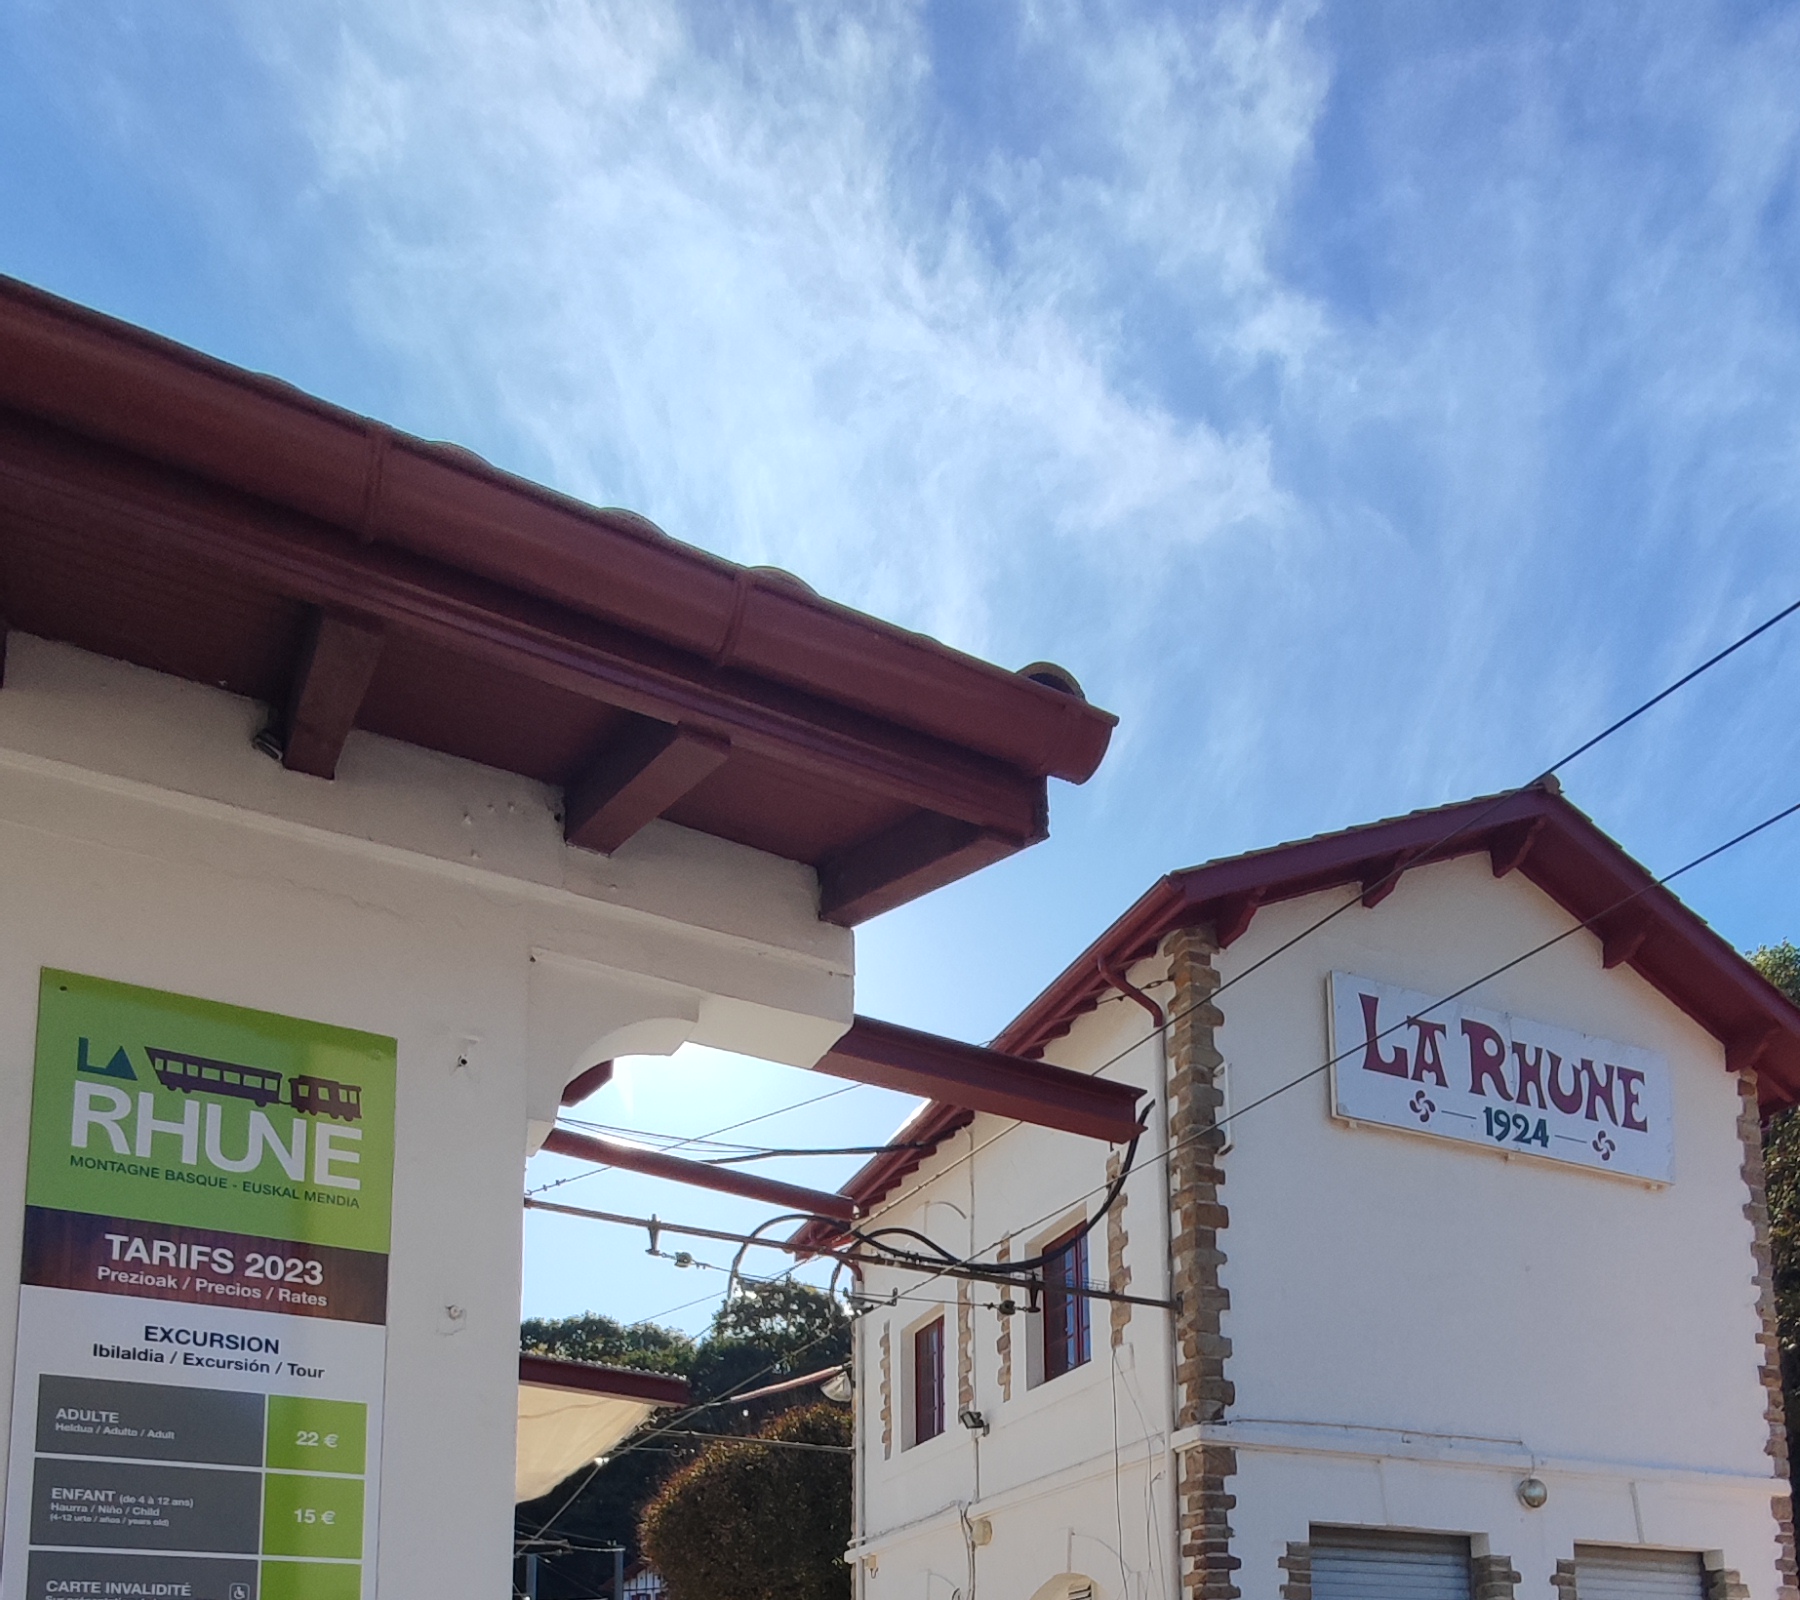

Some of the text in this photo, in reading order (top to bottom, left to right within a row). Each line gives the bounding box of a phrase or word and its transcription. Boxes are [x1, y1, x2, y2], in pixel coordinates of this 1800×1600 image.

[77, 1037, 138, 1081] LA
[1358, 992, 1648, 1133] LA RHUNE
[70, 1079, 363, 1191] RHUNE
[1482, 1106, 1550, 1148] 1924
[70, 1154, 160, 1179] MONTAGNE
[165, 1169, 228, 1189] BASQUE
[242, 1181, 300, 1200] EUSKAL
[304, 1190, 360, 1209] MENDIA
[104, 1233, 324, 1286] TARIFS 2023
[97, 1265, 178, 1290] Prezioak
[195, 1278, 262, 1299] Precios
[278, 1288, 328, 1307] Rates
[144, 1325, 279, 1354] EXCURSION
[93, 1343, 164, 1363] Ibilaldia
[183, 1352, 270, 1373] Excursión
[286, 1362, 325, 1379] Tour
[55, 1408, 120, 1424] ADULTE
[55, 1422, 93, 1434] Heldua
[103, 1426, 138, 1437] Adulto
[147, 1429, 175, 1440] Adult
[296, 1431, 338, 1448] 22 €
[50, 1502, 88, 1513] Haurra
[132, 1506, 160, 1517] Child
[51, 1487, 116, 1502] ENFANT
[119, 1494, 136, 1505] (de
[137, 1496, 145, 1504] 4
[158, 1497, 170, 1506] 12
[171, 1497, 194, 1509] ans)
[294, 1509, 336, 1525] 15 €
[46, 1580, 192, 1597] CARTE INVALIDITÉ
